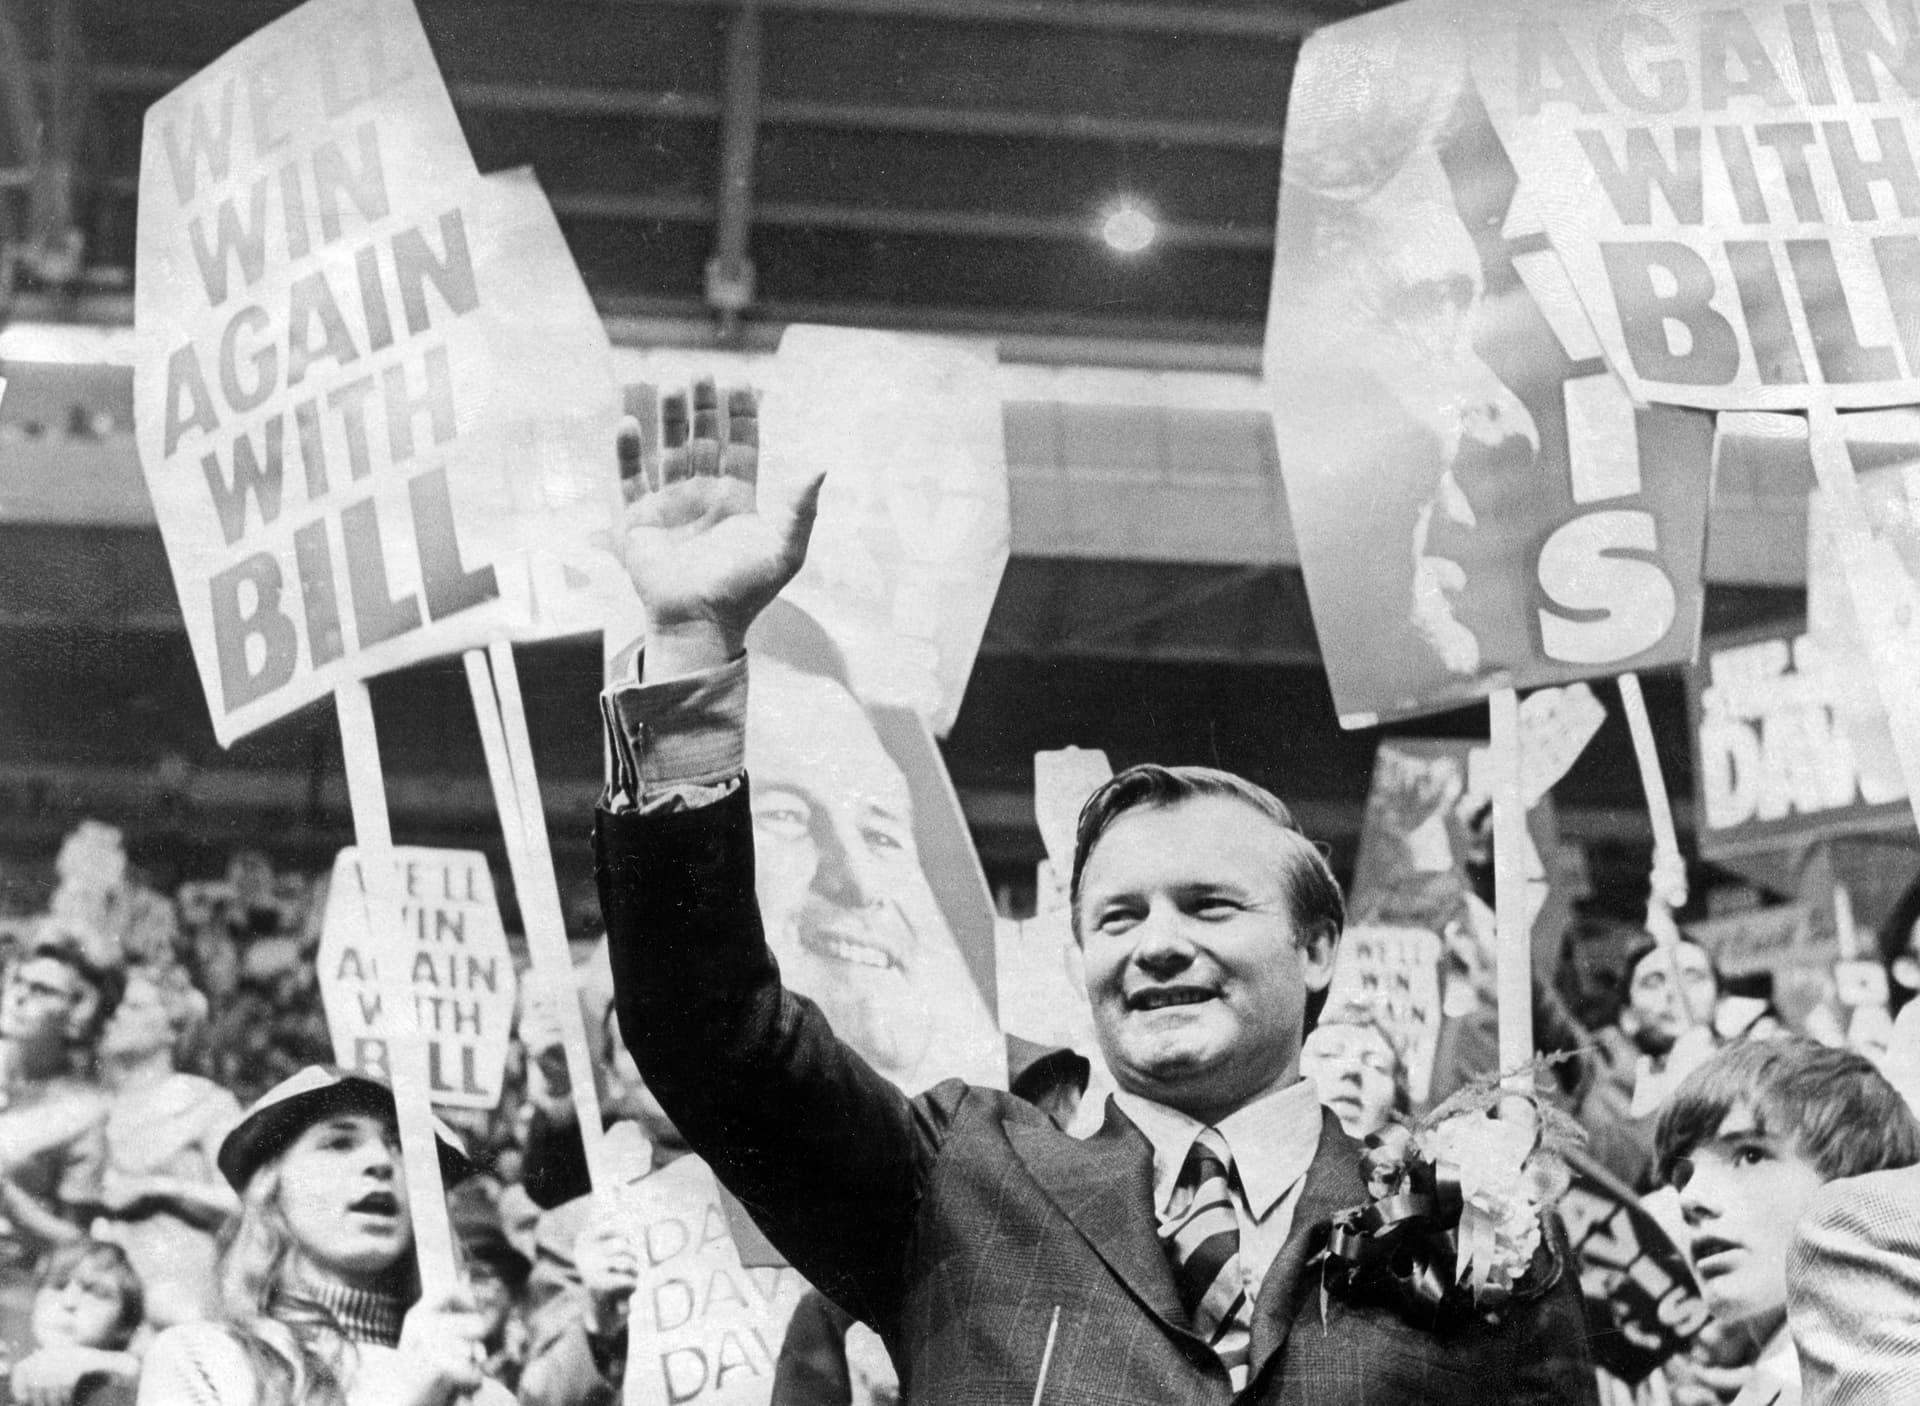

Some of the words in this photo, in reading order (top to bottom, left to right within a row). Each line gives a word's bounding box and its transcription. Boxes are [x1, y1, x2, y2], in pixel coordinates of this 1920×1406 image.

[1516, 0, 1920, 116] AGAIN
[187, 120, 390, 308] WIN
[1573, 116, 1920, 226] WITH
[163, 207, 481, 460] AGAIN
[200, 344, 459, 547] WITH
[210, 466, 501, 716] BILL
[337, 947, 497, 994] AAIN
[354, 1037, 490, 1095] BLL
